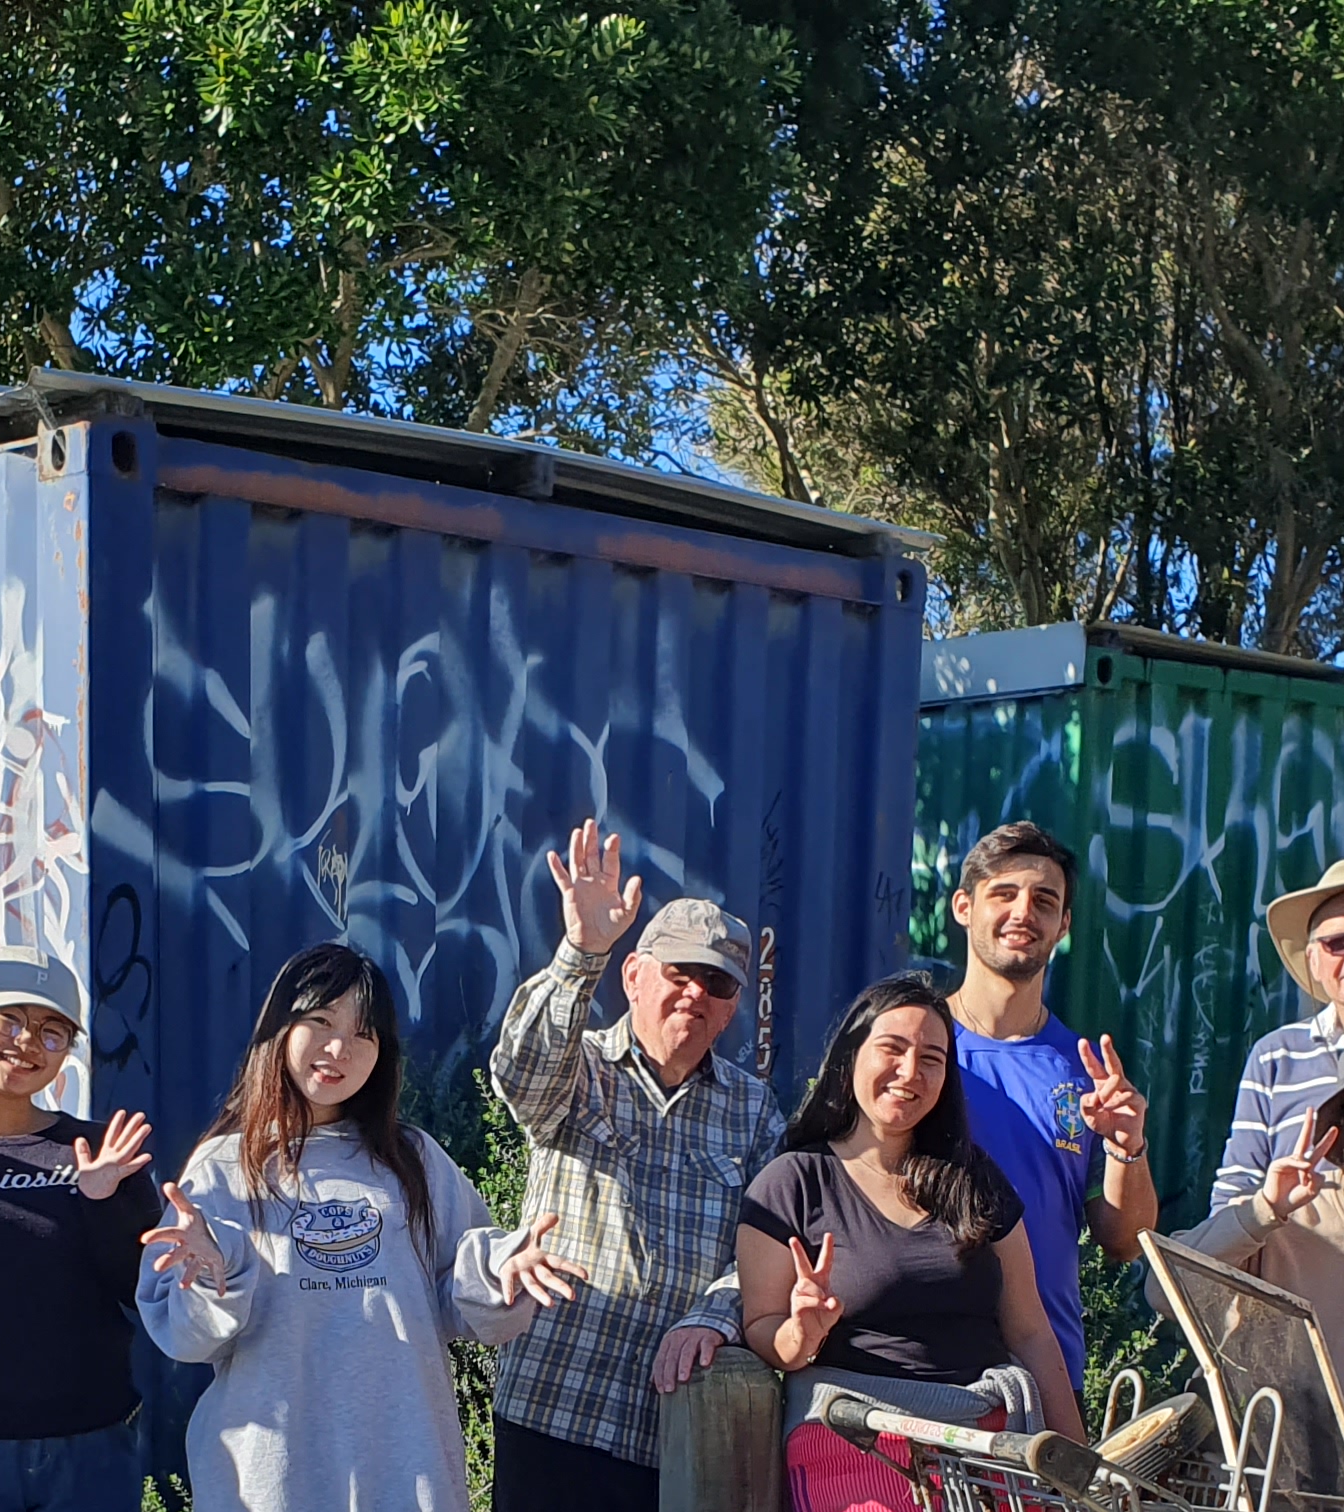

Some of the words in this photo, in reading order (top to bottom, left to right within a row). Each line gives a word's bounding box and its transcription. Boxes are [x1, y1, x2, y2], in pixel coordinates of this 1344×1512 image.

[36, 971, 48, 985] P
[321, 1205, 353, 1217] COPS
[308, 1245, 374, 1265] DOUGHNUTS
[299, 1277, 331, 1291] Clare,
[335, 1276, 387, 1290] Michigan
